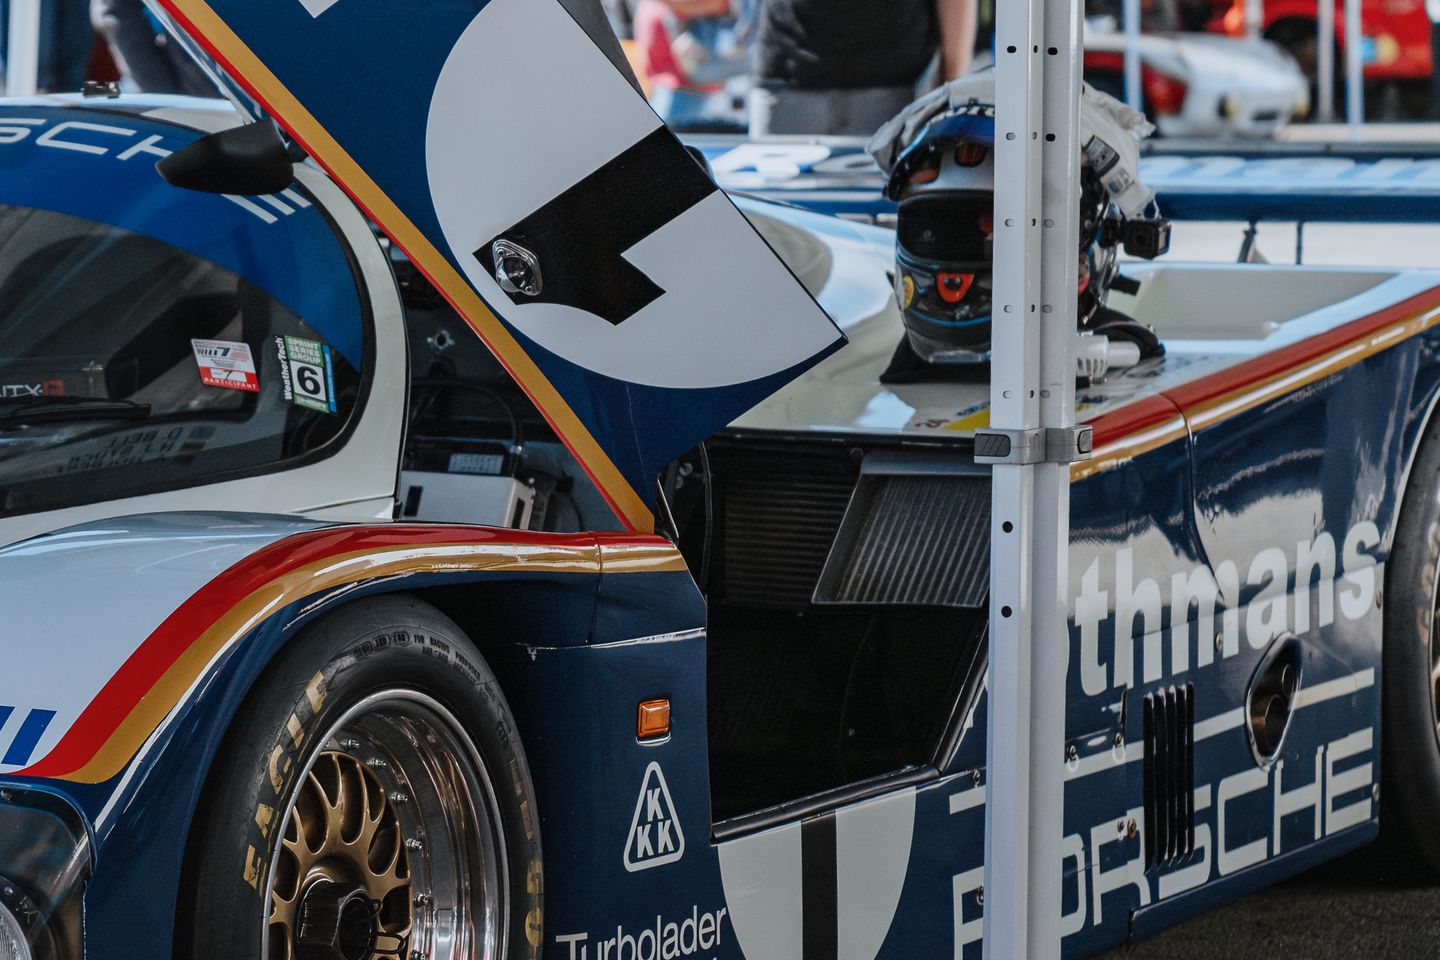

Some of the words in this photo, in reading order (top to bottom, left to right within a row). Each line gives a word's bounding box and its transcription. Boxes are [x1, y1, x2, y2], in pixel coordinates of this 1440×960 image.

[288, 337, 319, 349] SPRINT
[289, 345, 321, 357] SERIES
[290, 352, 321, 363] GROUP
[274, 337, 293, 400] WeatherTech
[203, 376, 257, 390] PARTICIPANT
[297, 366, 321, 395] 6
[1058, 521, 1380, 697] thmans
[647, 788, 664, 822] K
